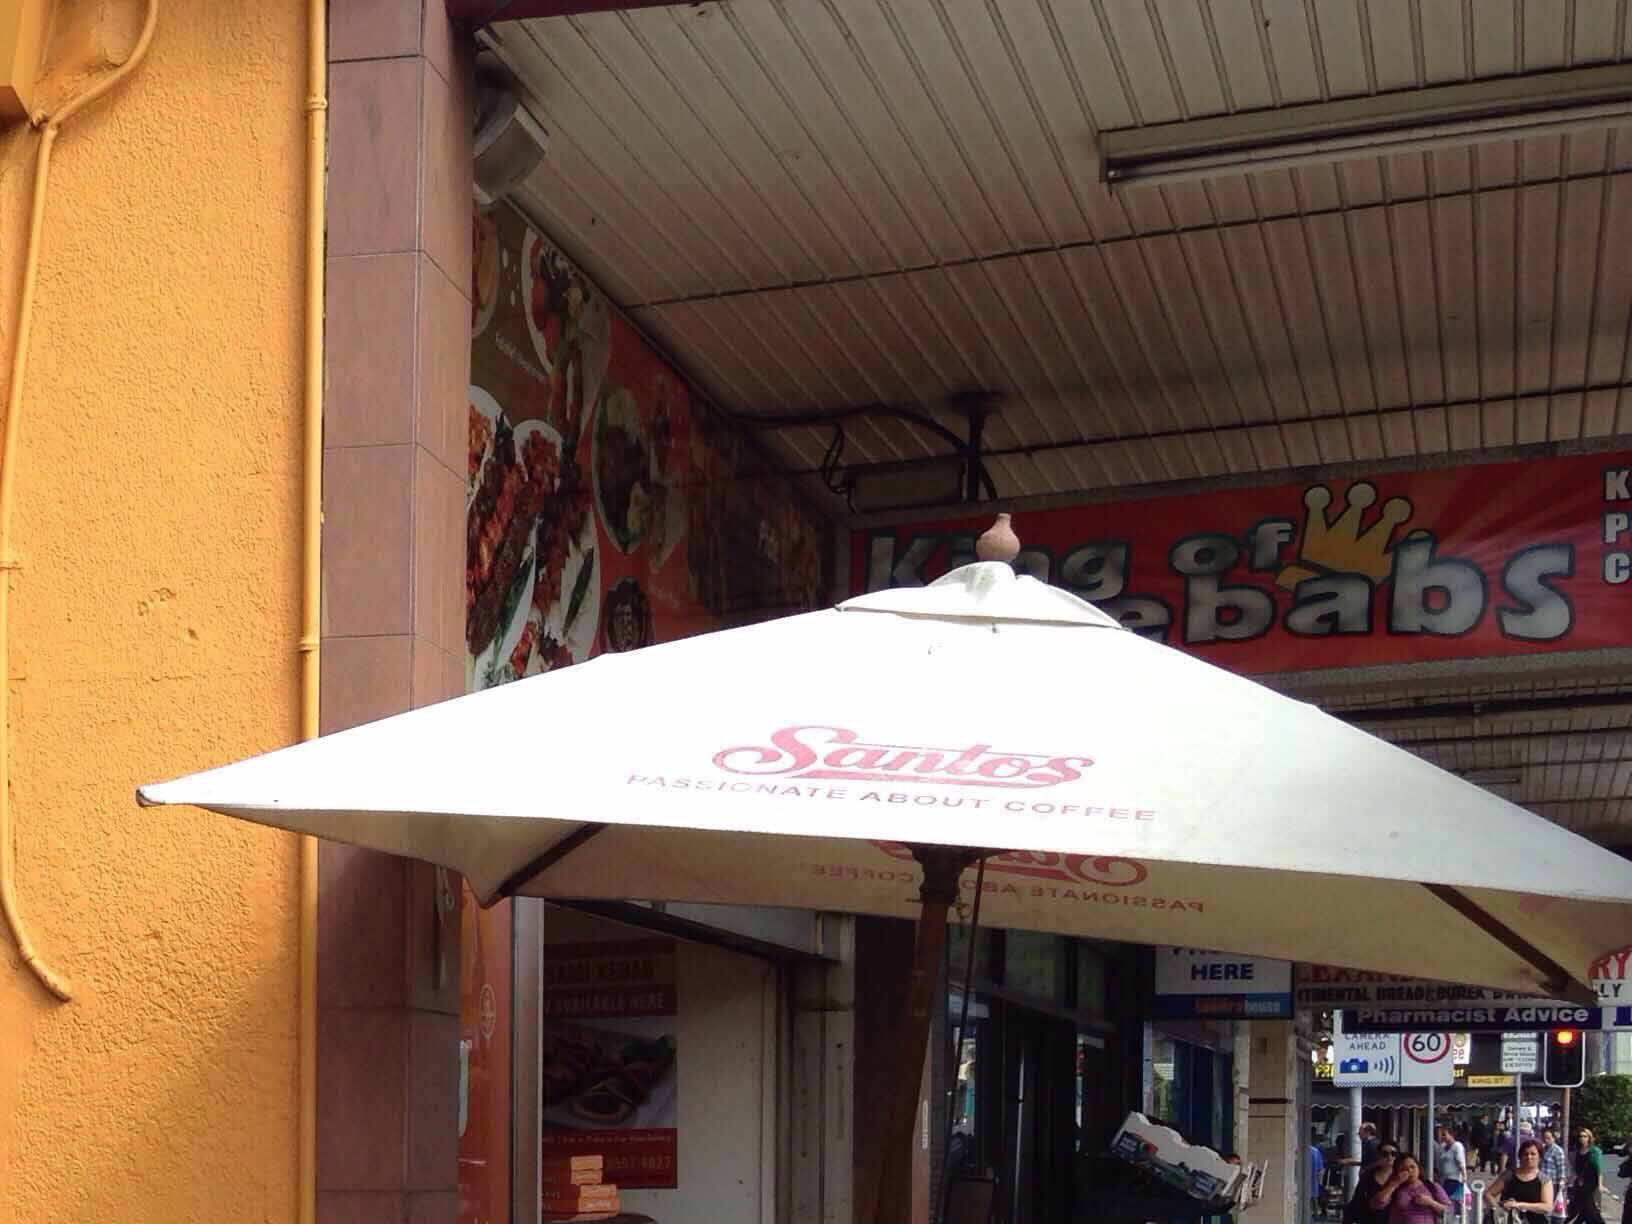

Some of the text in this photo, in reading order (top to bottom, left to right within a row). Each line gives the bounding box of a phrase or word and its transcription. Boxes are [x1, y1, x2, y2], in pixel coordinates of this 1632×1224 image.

[1168, 518, 1298, 579] of
[1115, 537, 1577, 645] ebabs
[711, 724, 1097, 789] Santos
[626, 774, 1158, 823] PASSIONATE ABOUT COFFEE
[1190, 962, 1255, 981] HERE
[1357, 1006, 1590, 1023] Pharmacist Advice
[1349, 1041, 1386, 1051] AHEAD
[1412, 1032, 1442, 1052] 60
